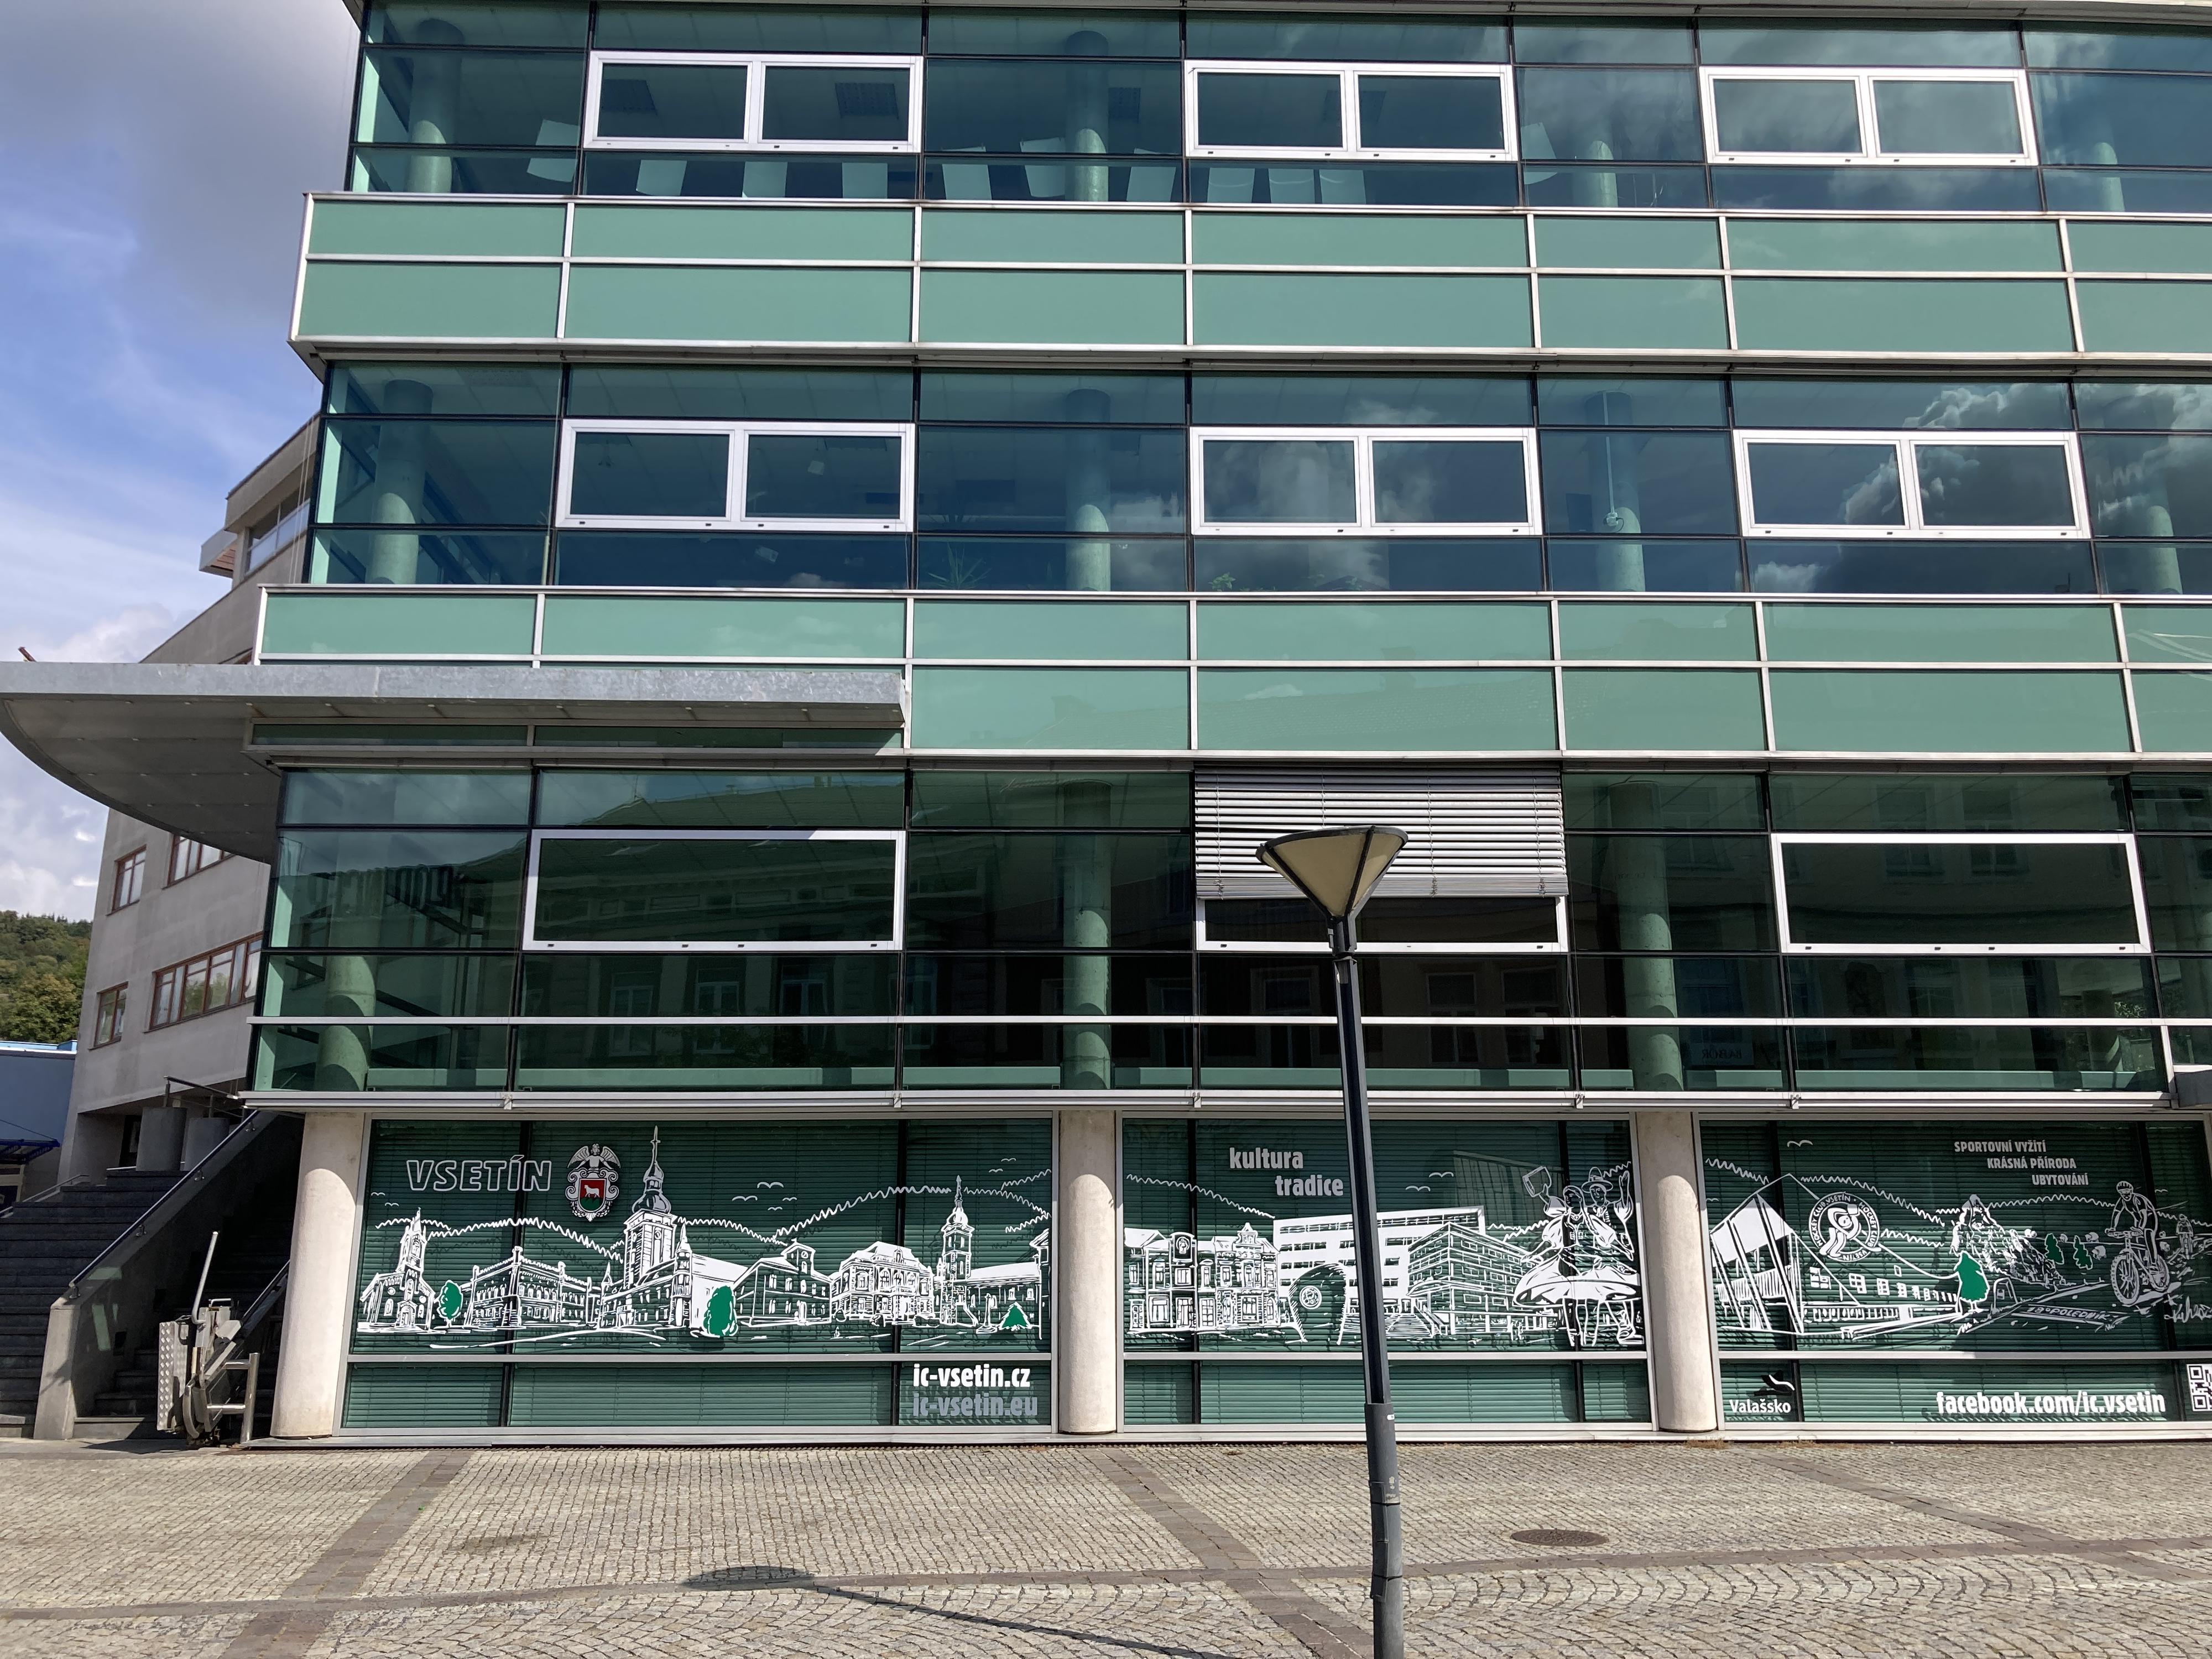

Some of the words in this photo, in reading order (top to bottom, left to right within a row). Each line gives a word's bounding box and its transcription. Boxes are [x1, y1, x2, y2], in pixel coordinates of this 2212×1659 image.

[1954, 1139, 2012, 1152] SPORTOVNÍ
[1229, 1147, 1303, 1170] kultura
[1987, 1156, 2028, 1168] KRÁSNÁ
[2030, 1156, 2077, 1168] PŘÍRODA
[406, 1154, 552, 1192] VSETÍN
[2032, 1172, 2089, 1186] UBYTOVÁNÍ
[1275, 1175, 1344, 1196] tradice
[913, 1363, 1030, 1387] ic-vsetin.cz
[913, 1392, 1038, 1416] ic-vsetin.eu
[1729, 1398, 1792, 1415] Valašsko
[1936, 1390, 2166, 1416] facebook.com/ic.vsetin
